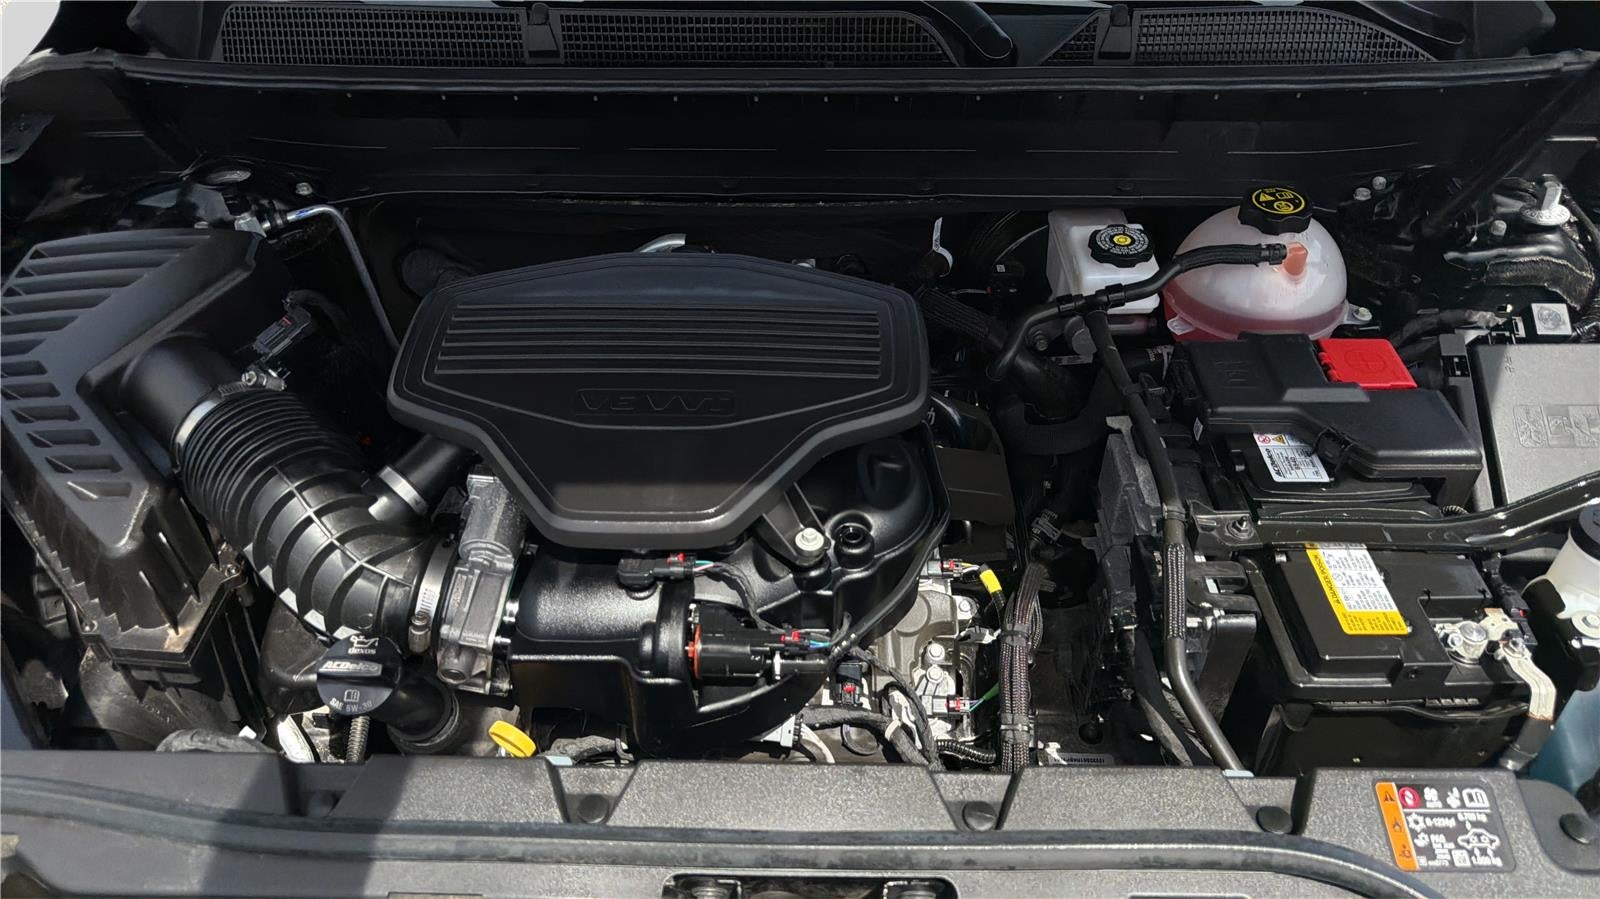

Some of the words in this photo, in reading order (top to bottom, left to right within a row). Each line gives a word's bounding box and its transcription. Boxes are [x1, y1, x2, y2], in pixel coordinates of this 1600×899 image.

[347, 647, 377, 655] dexos
[320, 660, 379, 672] ACDelco
[329, 697, 344, 711] SAE
